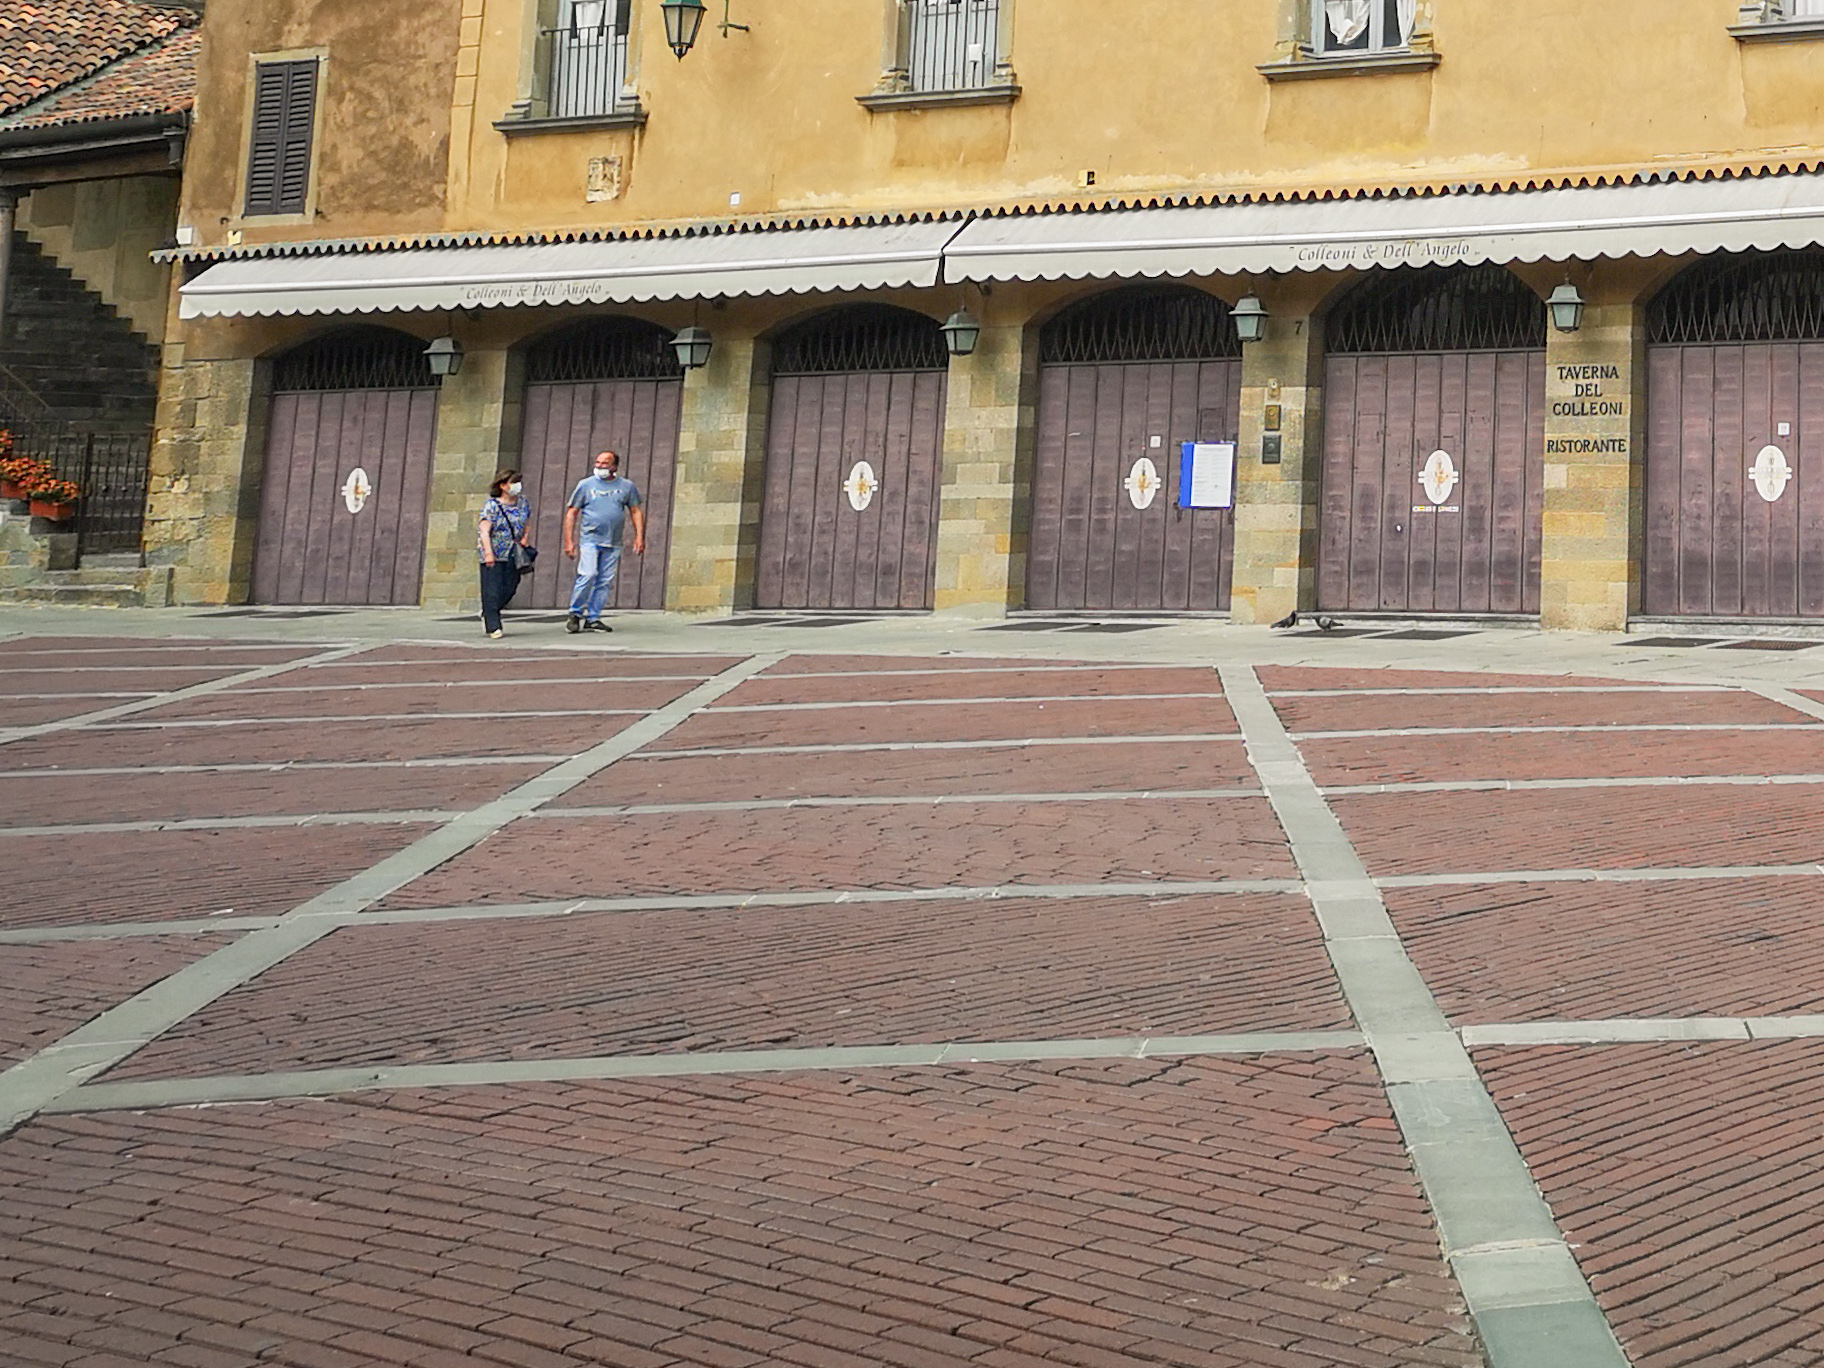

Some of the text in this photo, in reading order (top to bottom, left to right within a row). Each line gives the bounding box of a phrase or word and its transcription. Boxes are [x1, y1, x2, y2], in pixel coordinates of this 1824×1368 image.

[1363, 245, 1376, 259] &
[1295, 321, 1303, 335] 7
[1557, 365, 1620, 380] TAVERNA
[1574, 383, 1603, 398] DEL
[1552, 402, 1623, 416] COLLEONI
[1547, 439, 1627, 453] RISTORANTE
